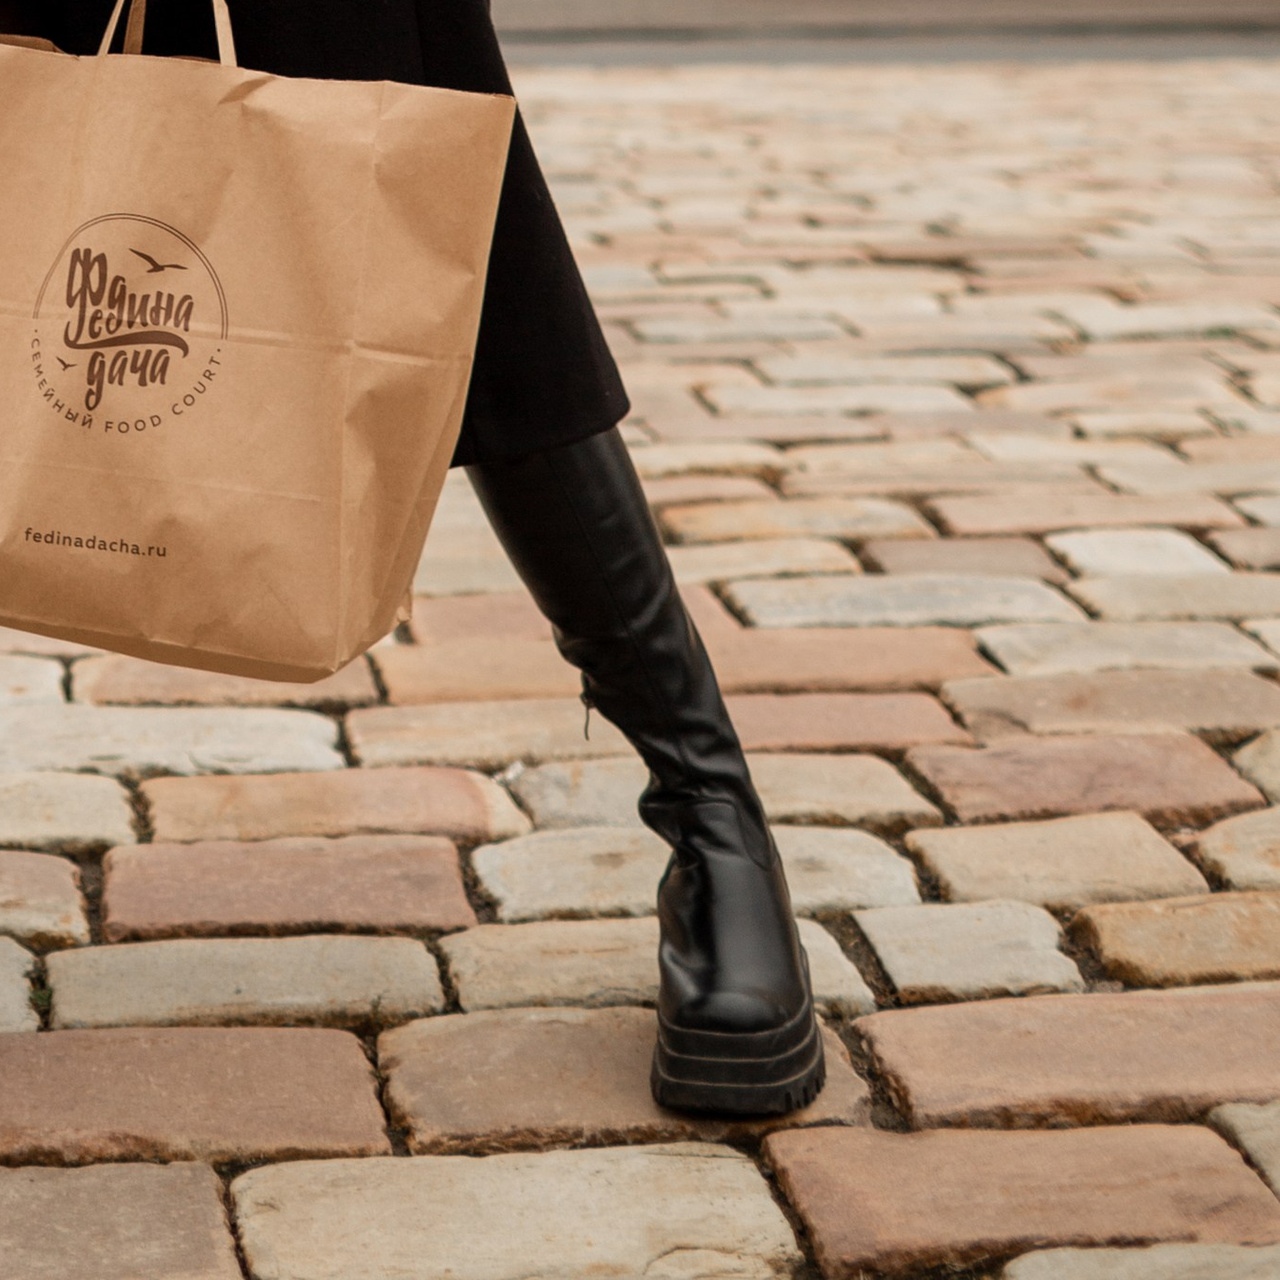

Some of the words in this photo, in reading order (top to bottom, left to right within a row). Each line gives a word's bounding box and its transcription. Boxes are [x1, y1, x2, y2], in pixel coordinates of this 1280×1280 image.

[64, 247, 194, 348] Федина
[30, 337, 93, 429] СЕМЕЙНЫЙ
[104, 414, 163, 434] FOOD
[171, 356, 222, 416] COURT
[85, 348, 171, 411] дача
[24, 527, 167, 558] fedinadacha.ru
